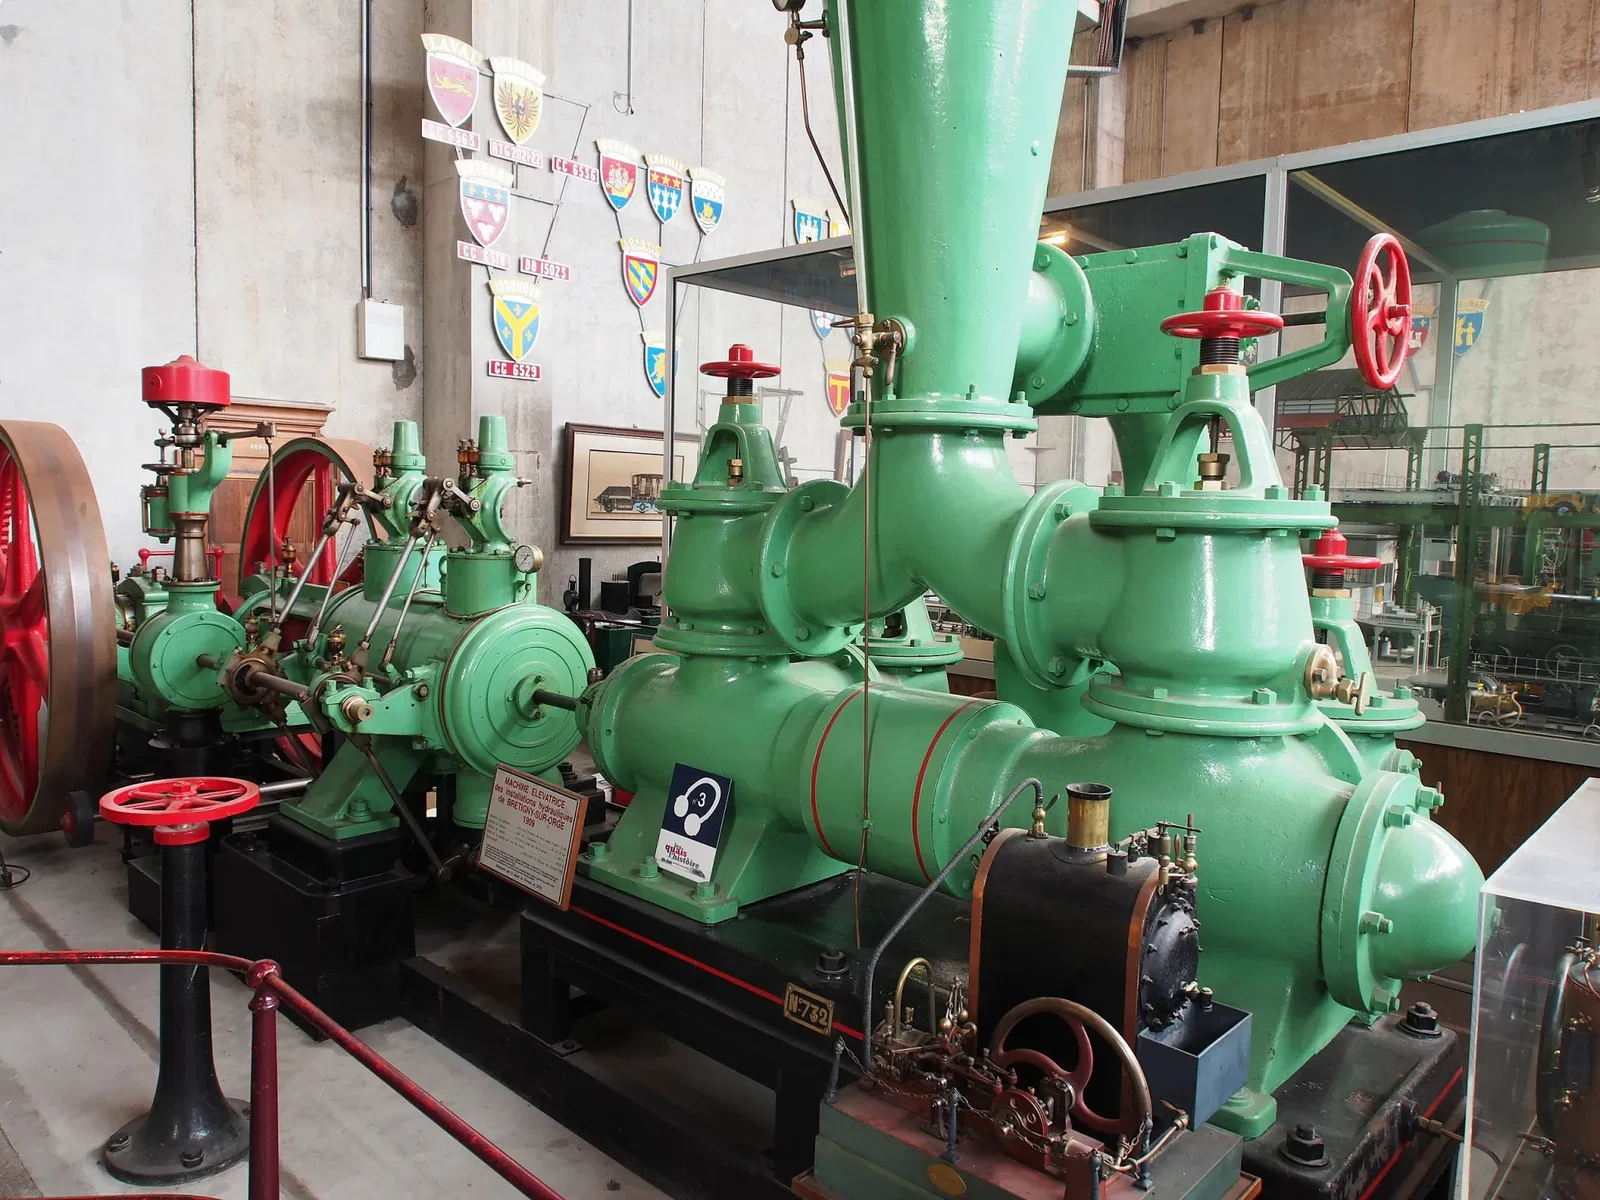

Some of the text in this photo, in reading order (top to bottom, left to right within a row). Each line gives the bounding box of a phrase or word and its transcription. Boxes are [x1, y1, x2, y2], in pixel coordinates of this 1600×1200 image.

[556, 158, 567, 172] CC
[463, 245, 476, 258] CC
[525, 259, 566, 278] BB 15023
[494, 362, 537, 377] CC 6529
[505, 777, 566, 809] MACHINE ELEVATRICE
[494, 784, 573, 824] des installations hydrauliques
[498, 796, 565, 831] de BRETIGNY-SUR-ORGE
[523, 816, 536, 828] 1909
[665, 844, 688, 858] quais
